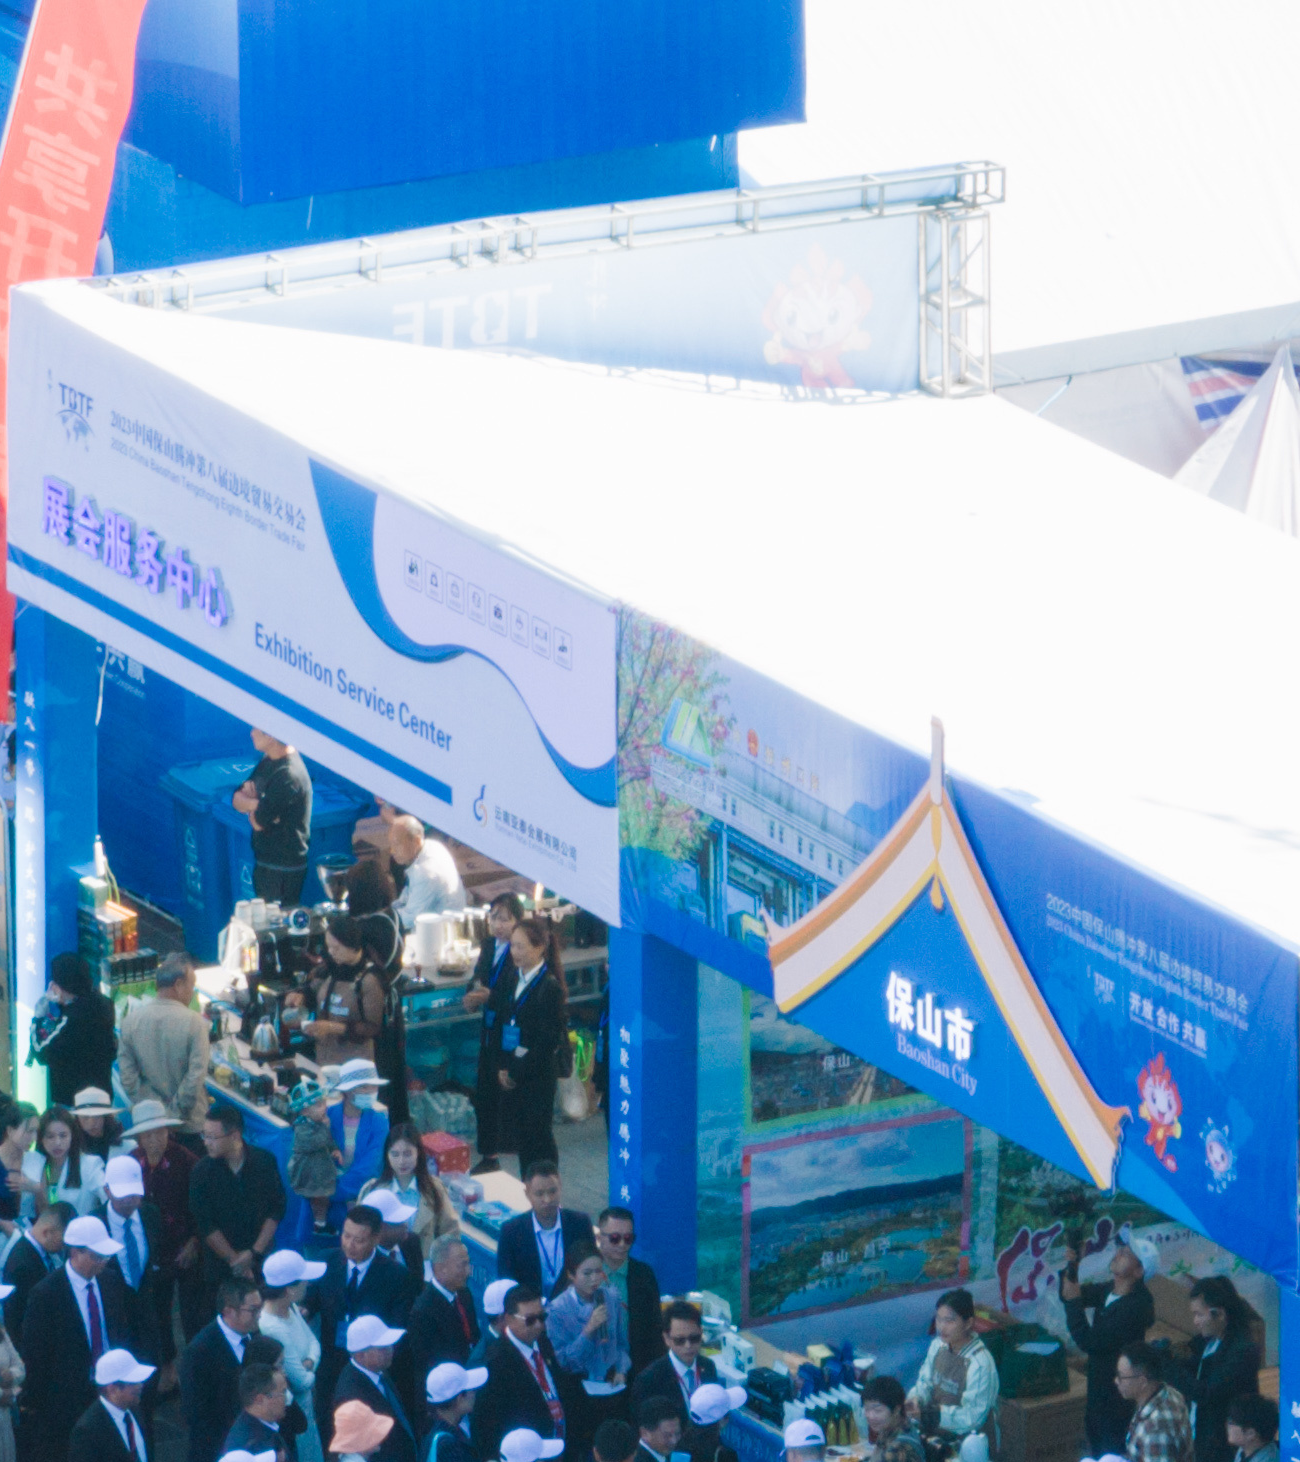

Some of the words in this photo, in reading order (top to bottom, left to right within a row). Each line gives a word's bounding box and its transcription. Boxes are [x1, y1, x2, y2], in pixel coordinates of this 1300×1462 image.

[58, 382, 94, 418] TBTF
[43, 475, 230, 628] 展会服务中心
[255, 621, 333, 688] Exhibition
[337, 668, 395, 721] Service
[399, 702, 452, 751] Center
[1046, 893, 1249, 1014] 2023中国保山腾冲第八届边境贸易交易会
[886, 970, 974, 1060] 保山市
[897, 1032, 950, 1079] Baoshan
[952, 1063, 977, 1096] City
[1129, 991, 1153, 1022] 开放
[1156, 1006, 1180, 1034] 合作
[1182, 1020, 1207, 1051] 共赢
[619, 1025, 632, 1167] 相聚魅力腾冲
